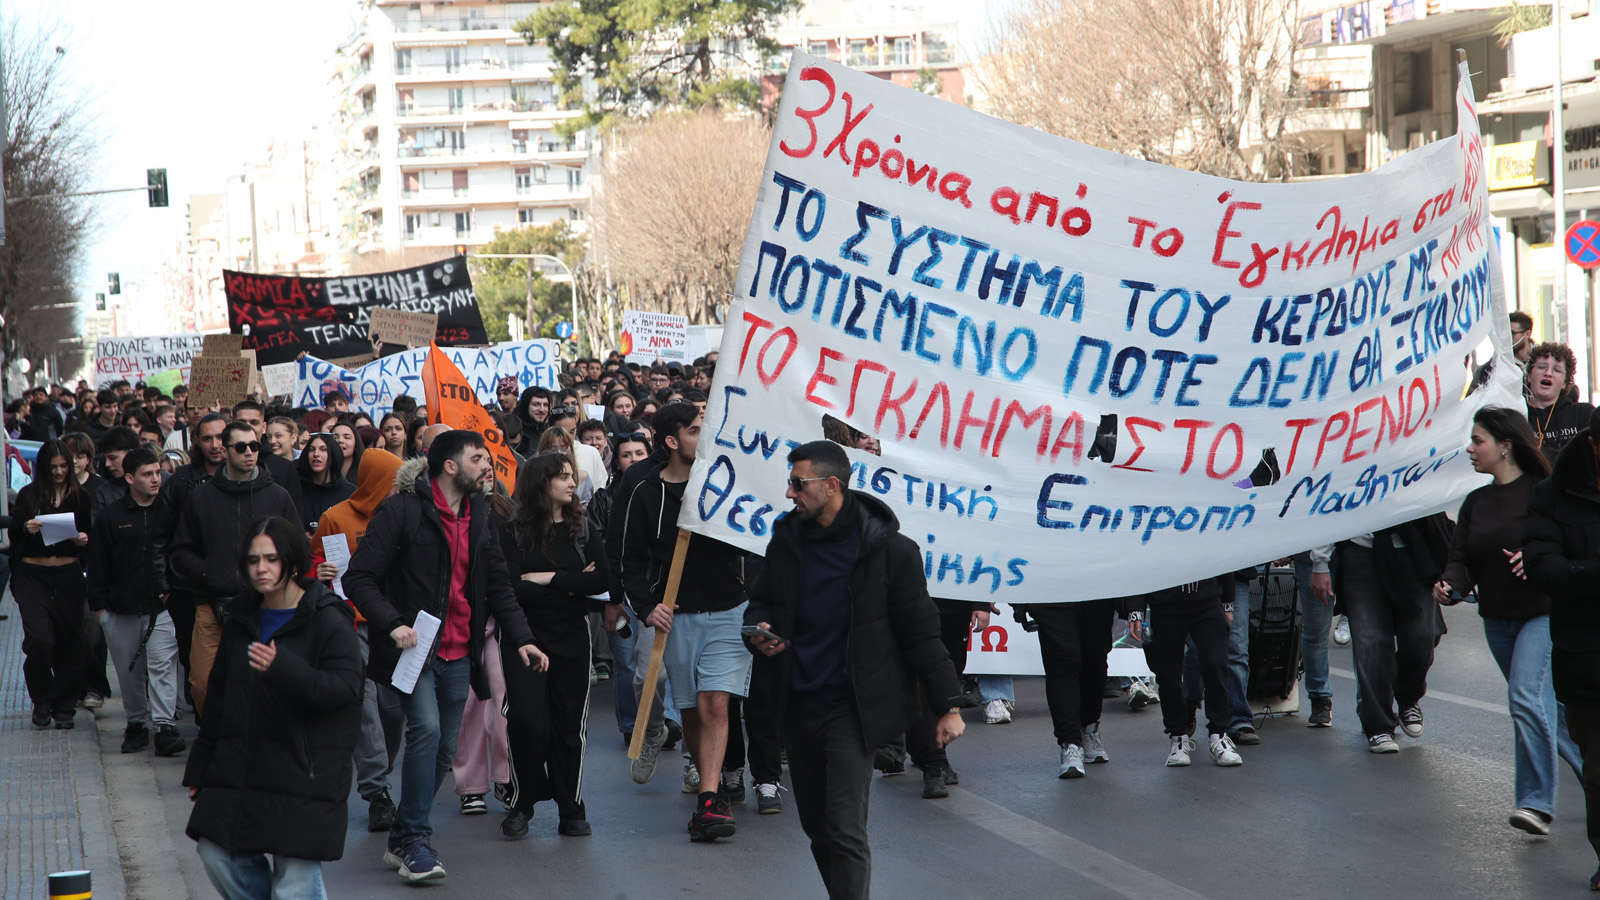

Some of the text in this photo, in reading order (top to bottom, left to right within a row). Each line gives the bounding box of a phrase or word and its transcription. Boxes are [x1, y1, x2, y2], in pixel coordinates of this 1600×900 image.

[780, 67, 836, 158] 3
[823, 91, 973, 209] Χρόνια
[991, 181, 1092, 236] από
[1128, 216, 1184, 257] το
[1211, 188, 1402, 289] Έγκλημα
[1568, 158, 1583, 171] ART
[773, 171, 826, 242] ΤΟ
[839, 200, 1087, 324] ΣΥΣΤΗΜΑ
[1119, 279, 1231, 338] ΤΟΥ
[1253, 259, 1397, 346] ΚΕΡΔΟΥΣ
[1403, 238, 1438, 302] ΜΕ
[325, 269, 429, 305] ΕΙΡΗΝΗ
[749, 240, 1038, 382] ΠΟΤΙΣΜΕΝΟ
[1063, 335, 1218, 407] ΠΟΤΕ
[1228, 350, 1340, 409] ΔΕΝ
[1349, 325, 1383, 395] ΘΑ
[97, 337, 151, 358] ΠΟΥΛΑΤΕ
[160, 336, 187, 351] ΤΗΝ
[474, 343, 546, 371] ΑΥΤΟ
[649, 335, 672, 348] ΑΙΜΑ
[142, 354, 167, 370] ΤΗΝ
[361, 379, 393, 406] ΘΑ
[738, 311, 1442, 481] ΤΟ ΕΓΚΛΗΜΑ ΣΤΟ ΤΡΕΝΟ!
[1036, 472, 1257, 546] Επιτροπή
[1279, 446, 1460, 518] Μαθητών
